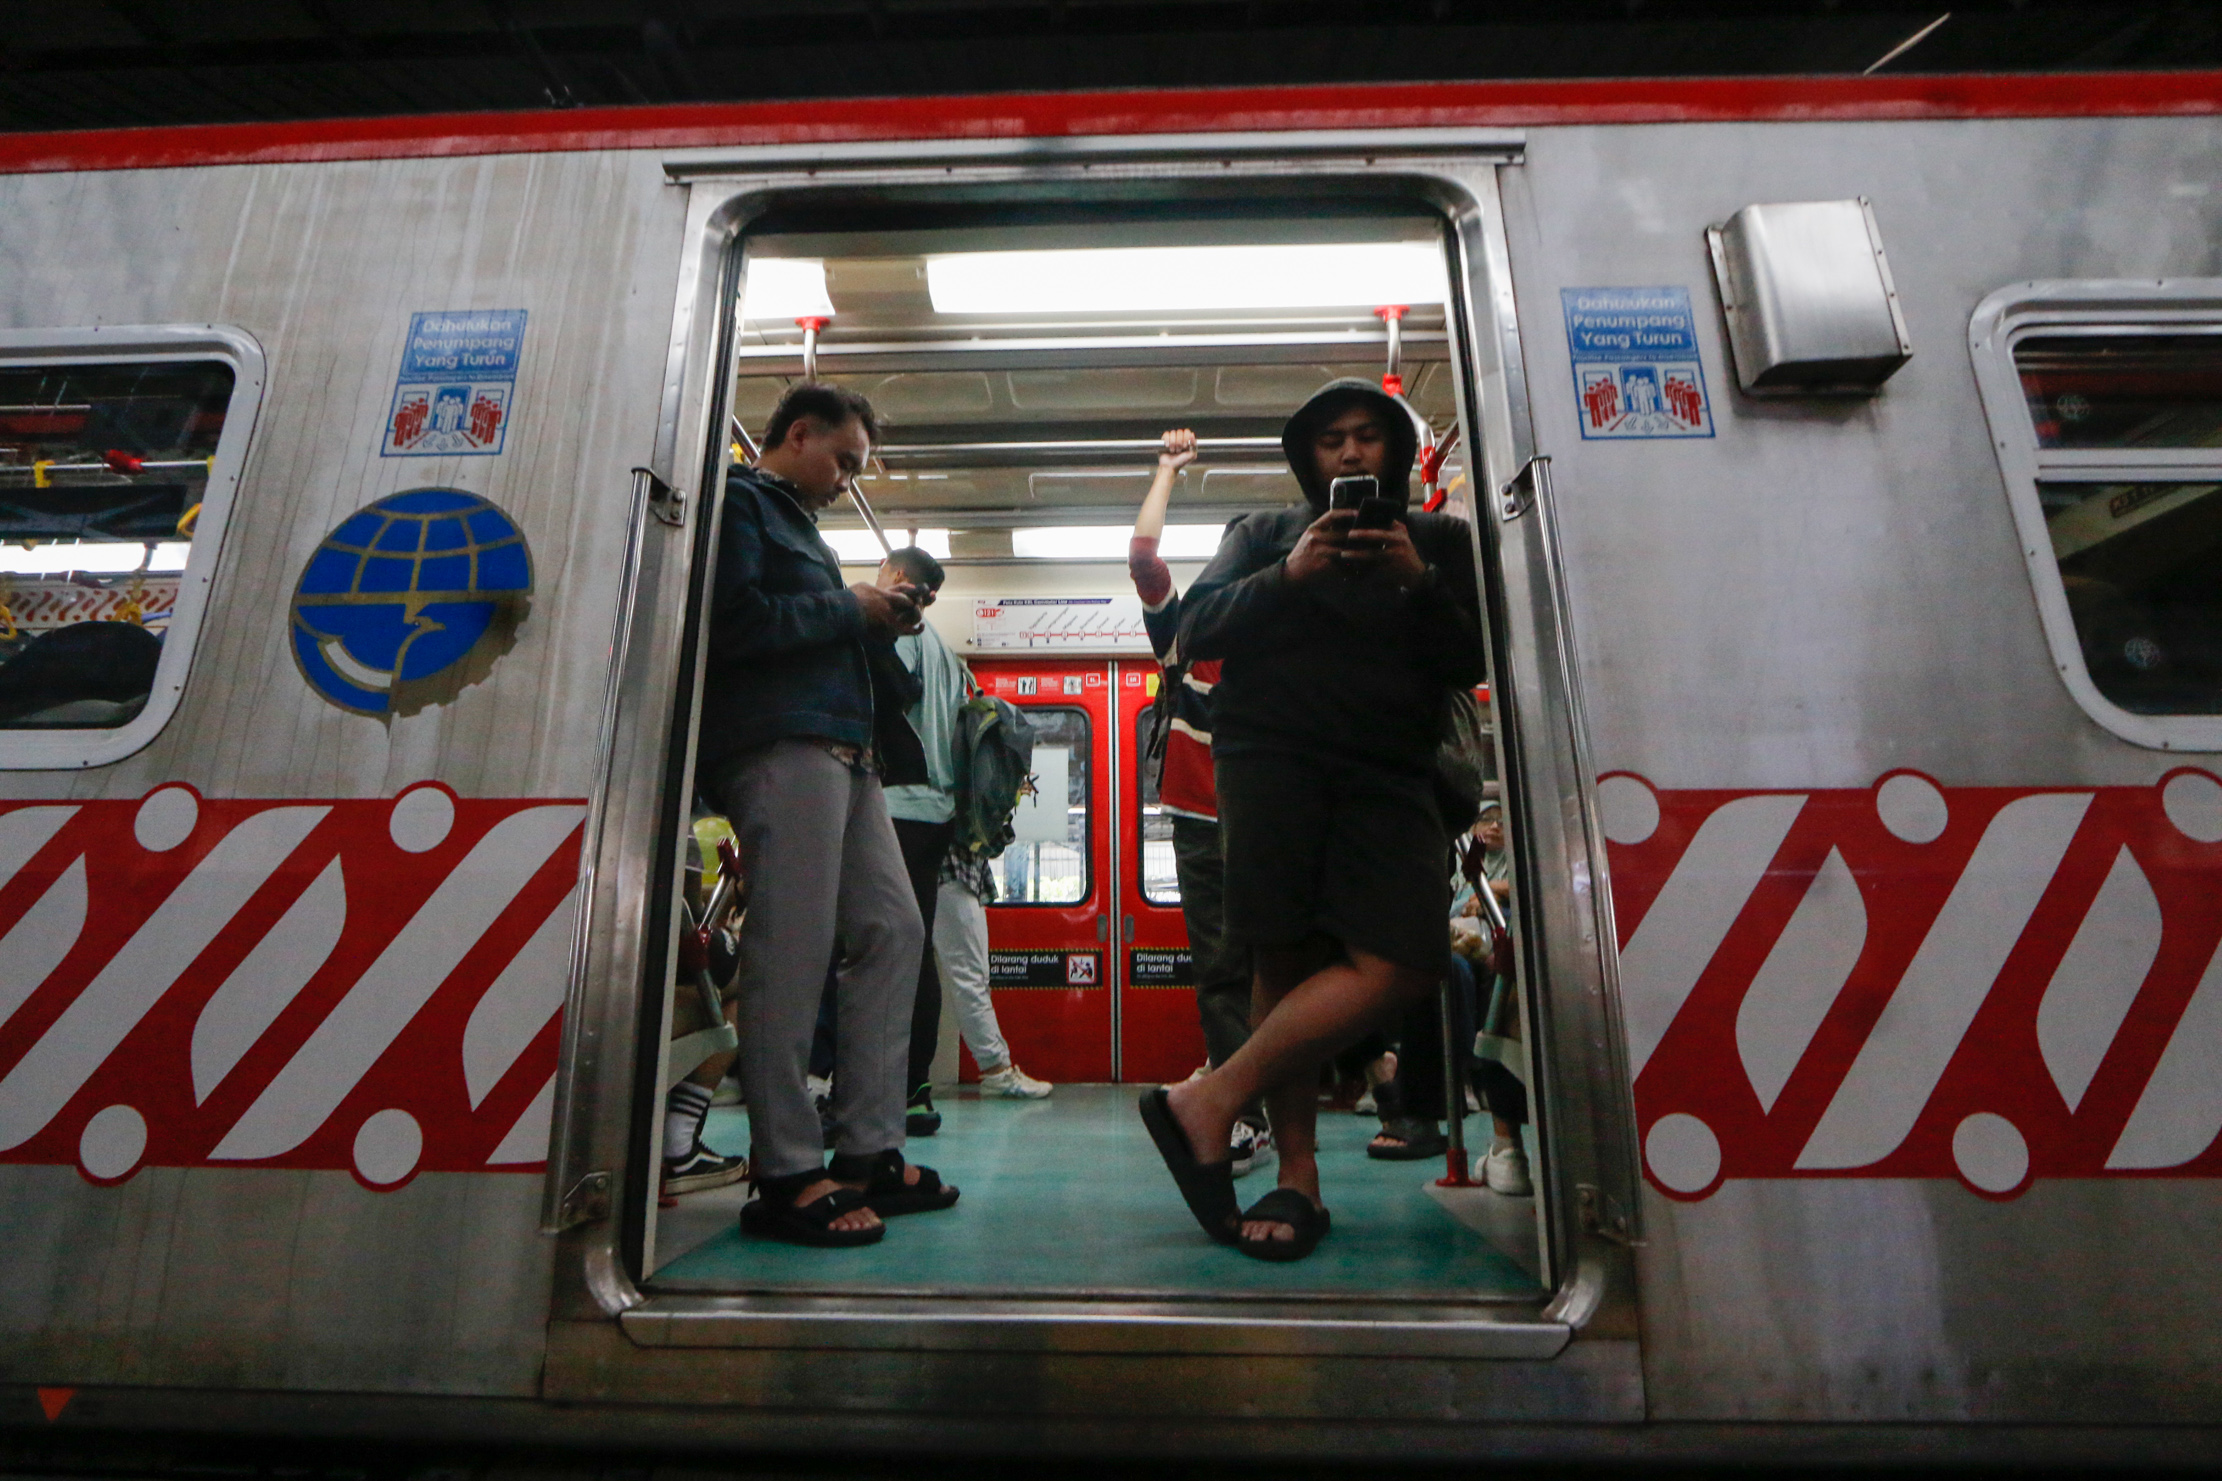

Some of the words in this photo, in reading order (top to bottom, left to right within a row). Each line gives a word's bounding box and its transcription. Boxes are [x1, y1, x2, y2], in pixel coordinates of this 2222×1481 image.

[1578, 296, 1675, 310] Dahuukan
[423, 319, 511, 333] Dahulukan
[1573, 314, 1685, 330] Penumpang
[413, 337, 515, 350] Penumpang
[1581, 331, 1630, 349] Yang
[1633, 331, 1682, 345] Turun
[416, 355, 458, 369] Yang
[462, 353, 506, 366] Turun
[990, 954, 1028, 966] Dilarang
[1030, 954, 1059, 964] duduk
[1136, 952, 1174, 964] Dilarang
[990, 965, 999, 974] di
[1001, 965, 1027, 974] lantai
[1136, 963, 1145, 973] di
[1147, 963, 1173, 973] lantai
